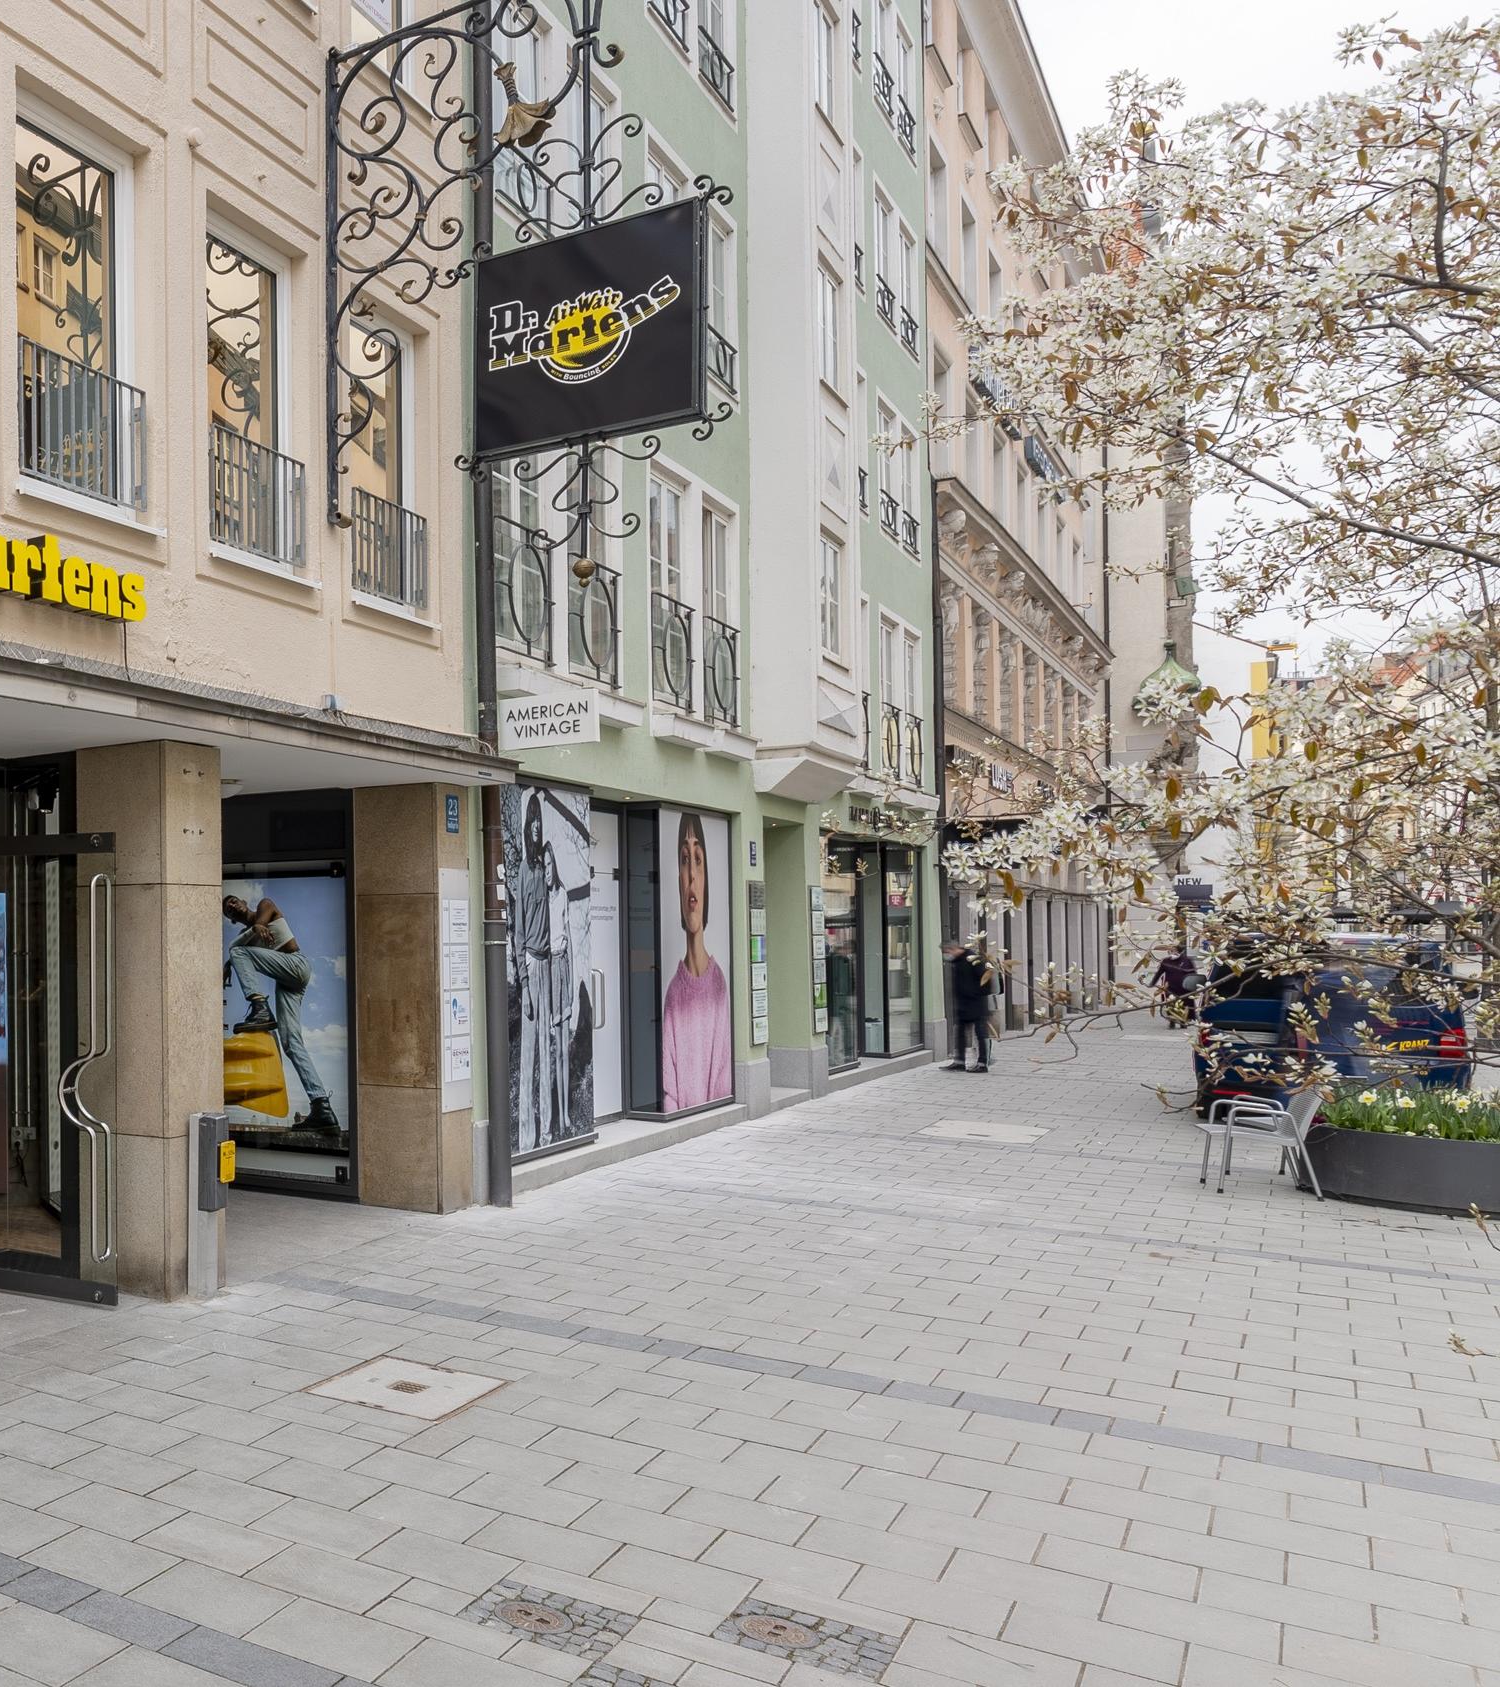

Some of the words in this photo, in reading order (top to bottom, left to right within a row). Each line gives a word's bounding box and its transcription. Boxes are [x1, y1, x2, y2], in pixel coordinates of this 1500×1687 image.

[489, 275, 680, 371] Martens
[563, 367, 601, 380] Bouncing
[506, 700, 588, 723] AMERICAN
[514, 719, 581, 738] VINTAGE
[448, 799, 458, 816] 23
[1178, 877, 1202, 886] NEW
